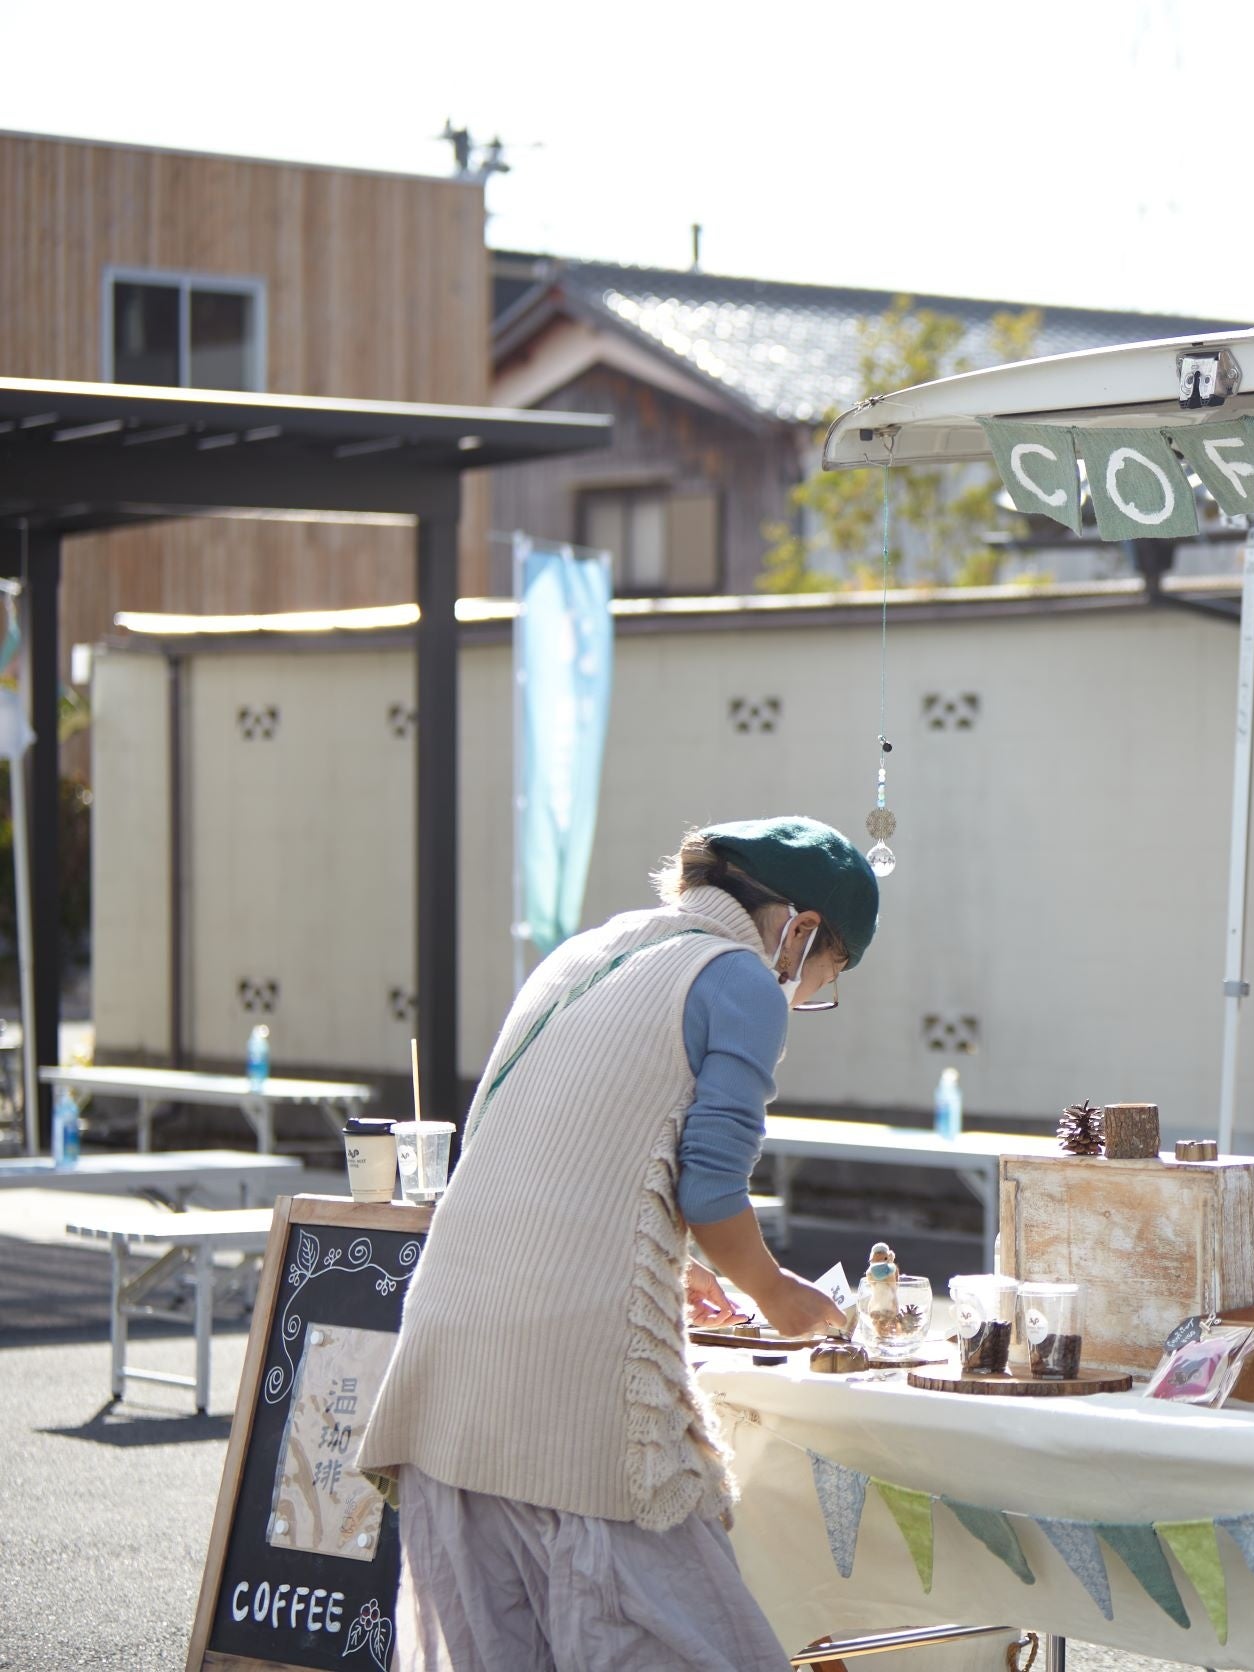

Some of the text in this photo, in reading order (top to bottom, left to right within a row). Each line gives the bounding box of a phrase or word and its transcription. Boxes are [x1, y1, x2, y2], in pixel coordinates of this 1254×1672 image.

[312, 1377, 358, 1496] 温珈琲
[232, 1580, 345, 1633] COFFEE
